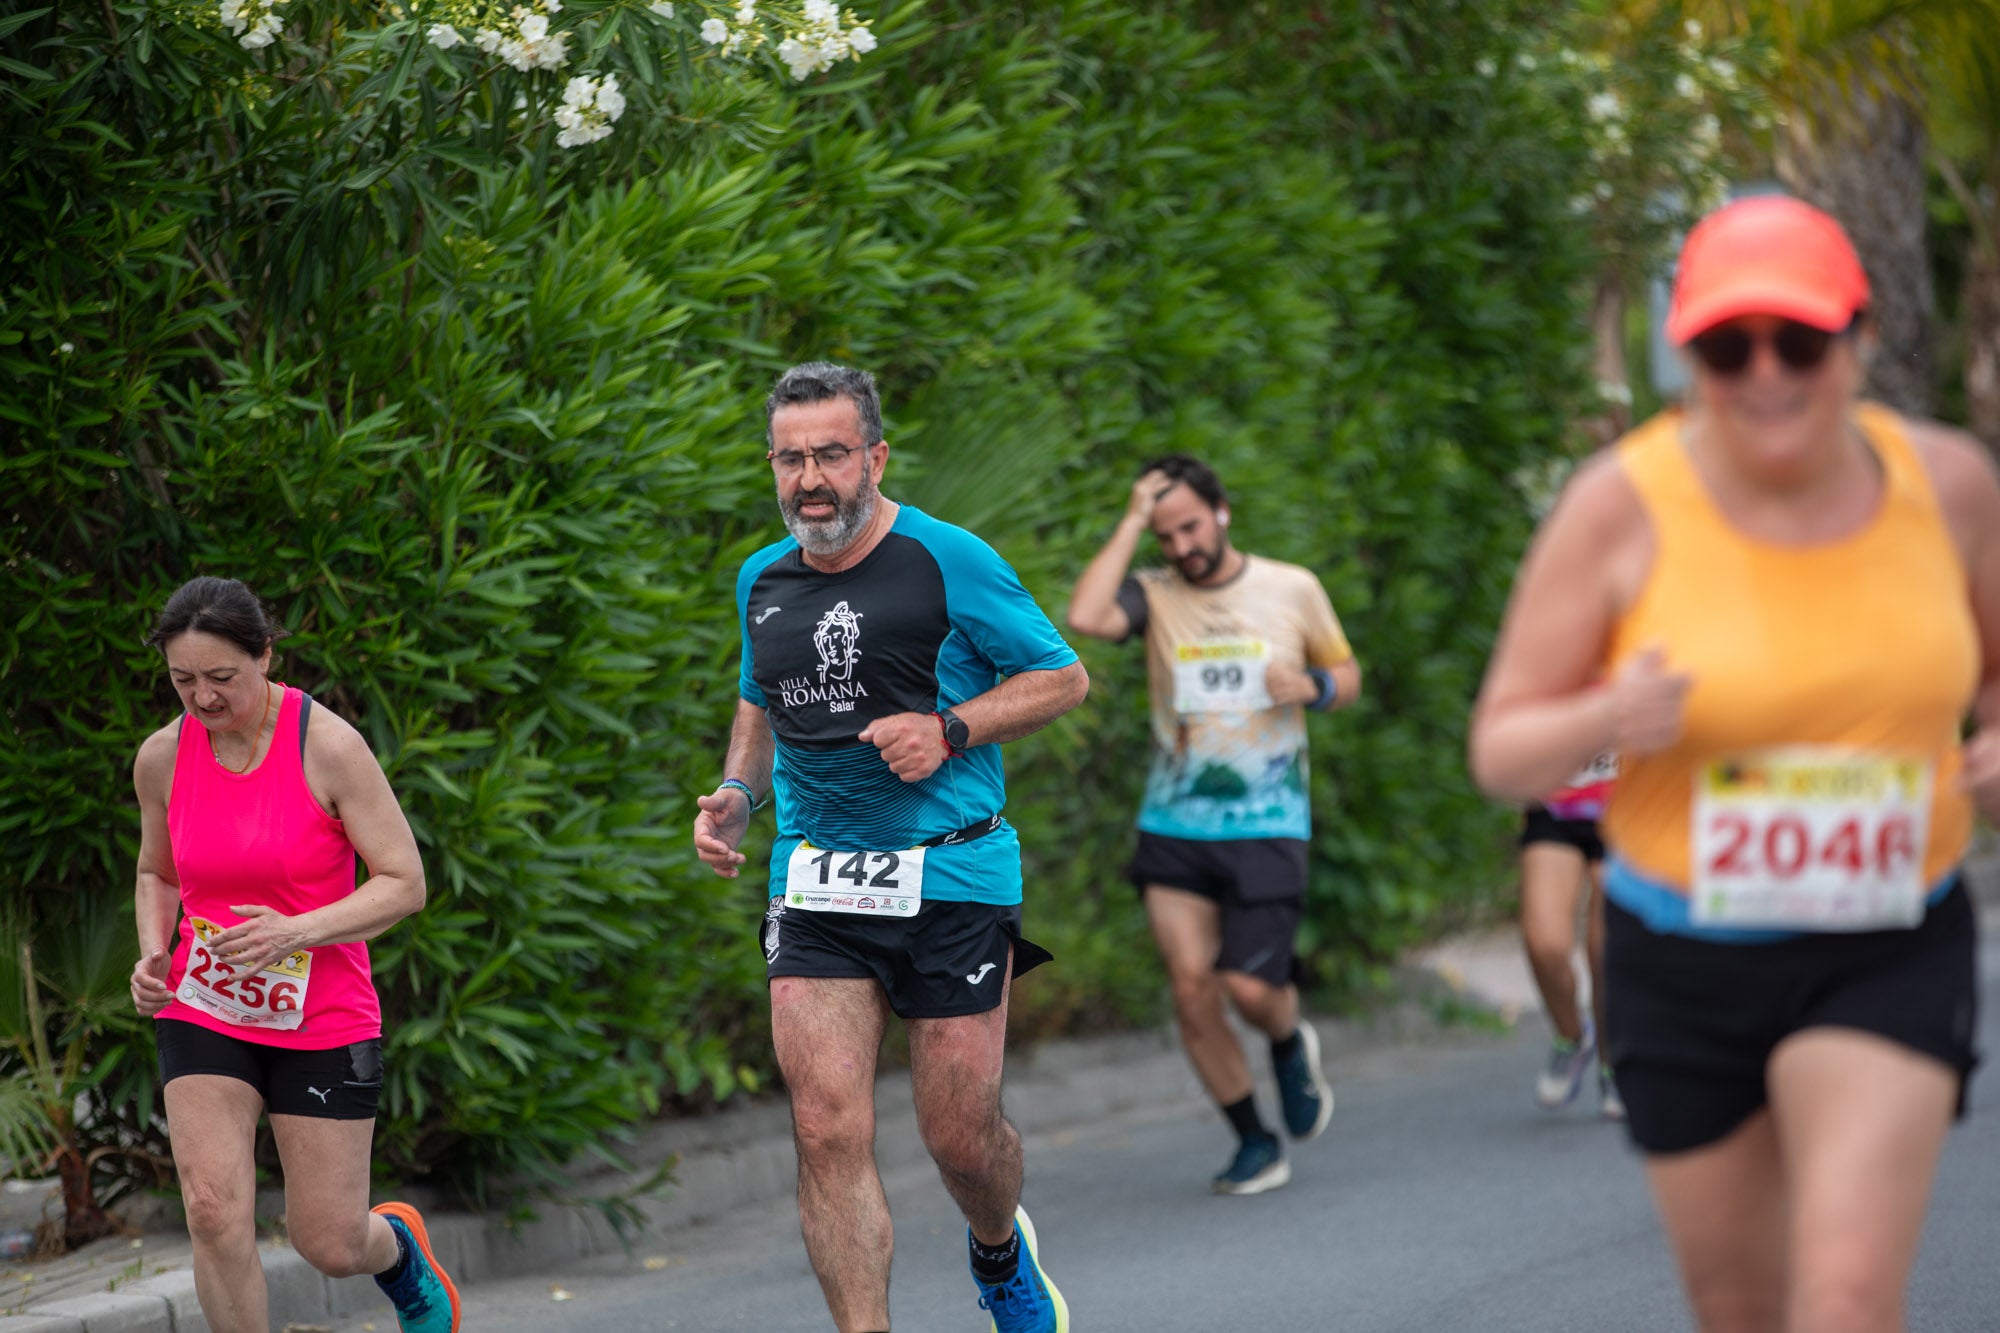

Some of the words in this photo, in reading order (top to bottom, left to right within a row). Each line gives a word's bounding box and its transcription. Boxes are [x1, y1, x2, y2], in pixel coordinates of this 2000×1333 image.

[779, 676, 811, 692] VILLA
[1201, 665, 1244, 693] 99
[781, 681, 870, 708] ROMANA
[829, 700, 855, 713] Salar
[810, 850, 900, 889] 142
[189, 946, 299, 1013] 2256
